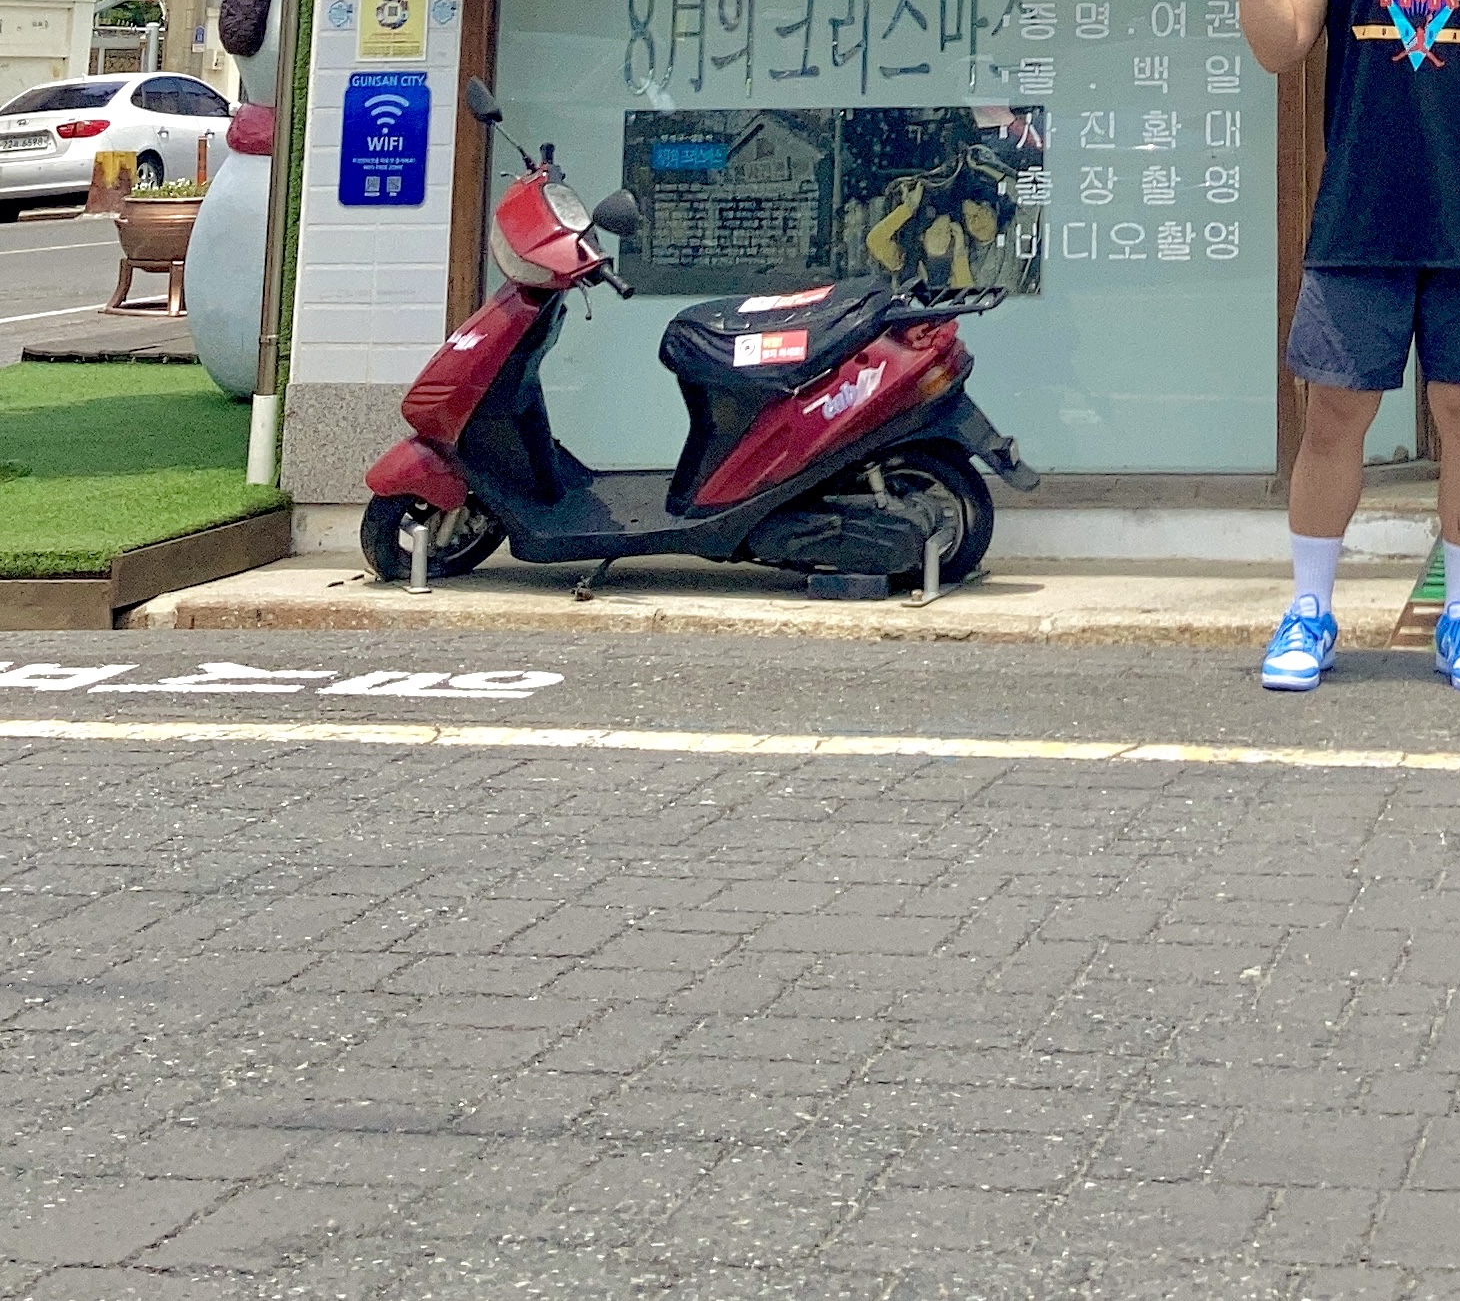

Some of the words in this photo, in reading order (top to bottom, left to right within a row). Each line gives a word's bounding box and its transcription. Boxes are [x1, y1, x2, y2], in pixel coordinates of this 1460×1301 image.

[352, 75, 398, 87] GUNSAN
[400, 75, 425, 86] CITY
[367, 136, 404, 152] WIFI
